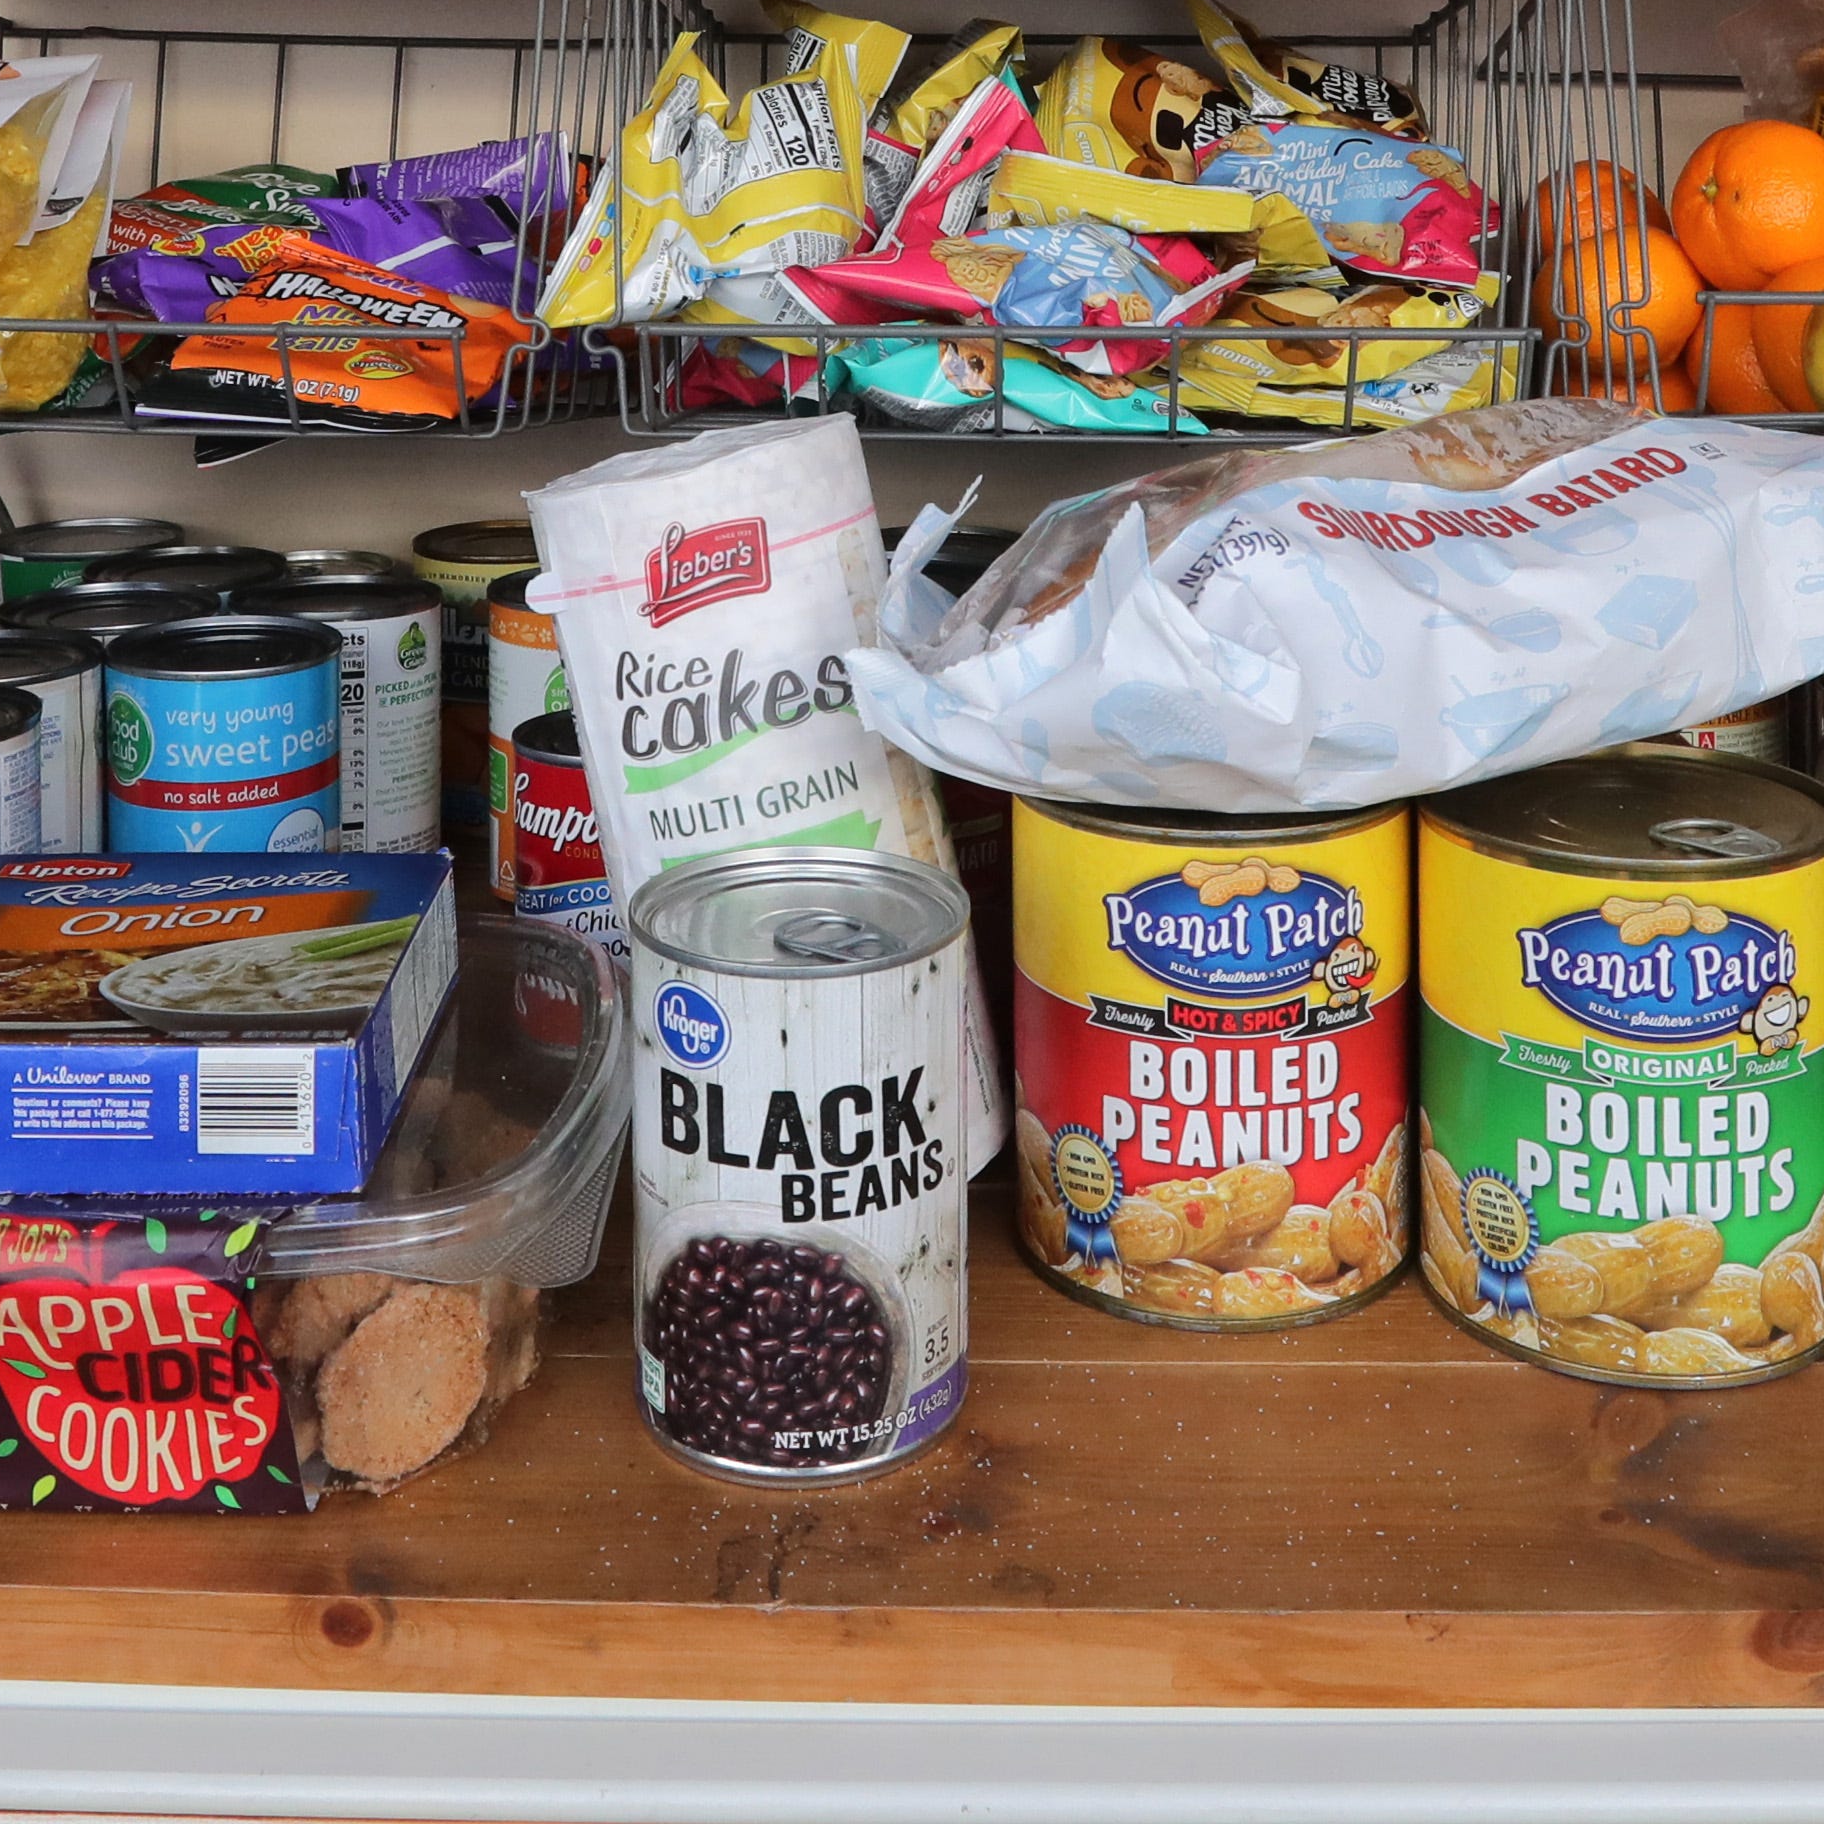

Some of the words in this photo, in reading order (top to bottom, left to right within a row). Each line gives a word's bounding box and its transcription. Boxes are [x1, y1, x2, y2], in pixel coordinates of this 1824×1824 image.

[1297, 499, 1535, 553] SOURDOUGH
[1538, 445, 1688, 520] BATARD
[617, 650, 713, 700] Rice
[622, 648, 855, 760] cakes
[166, 708, 215, 729] very
[227, 699, 295, 732] young
[167, 729, 273, 769] sweet
[281, 721, 335, 767] peas
[162, 791, 183, 805] no
[186, 786, 220, 804] salt
[227, 781, 280, 802] added
[649, 795, 742, 841] MULTI
[756, 761, 860, 818] GRAIN
[3, 863, 121, 879] Lipton
[59, 903, 266, 937] Onion
[1106, 894, 1250, 956] Peanut
[1265, 890, 1363, 958] Patch
[1521, 929, 1674, 1001] Peanut
[1691, 932, 1797, 1001] Patch
[179, 1074, 190, 1132] 83292096
[1129, 1040, 1339, 1107] BOILED
[660, 1066, 927, 1171] BLACK
[1102, 1092, 1362, 1168] PEANUTS
[1546, 1084, 1772, 1157] BOILED
[782, 1140, 944, 1224] BEANS
[1517, 1140, 1795, 1222] PEANUTS
[10, 1223, 72, 1264] JOE'S
[75, 1334, 272, 1405] CIDER
[25, 1384, 270, 1494] COOKIES
